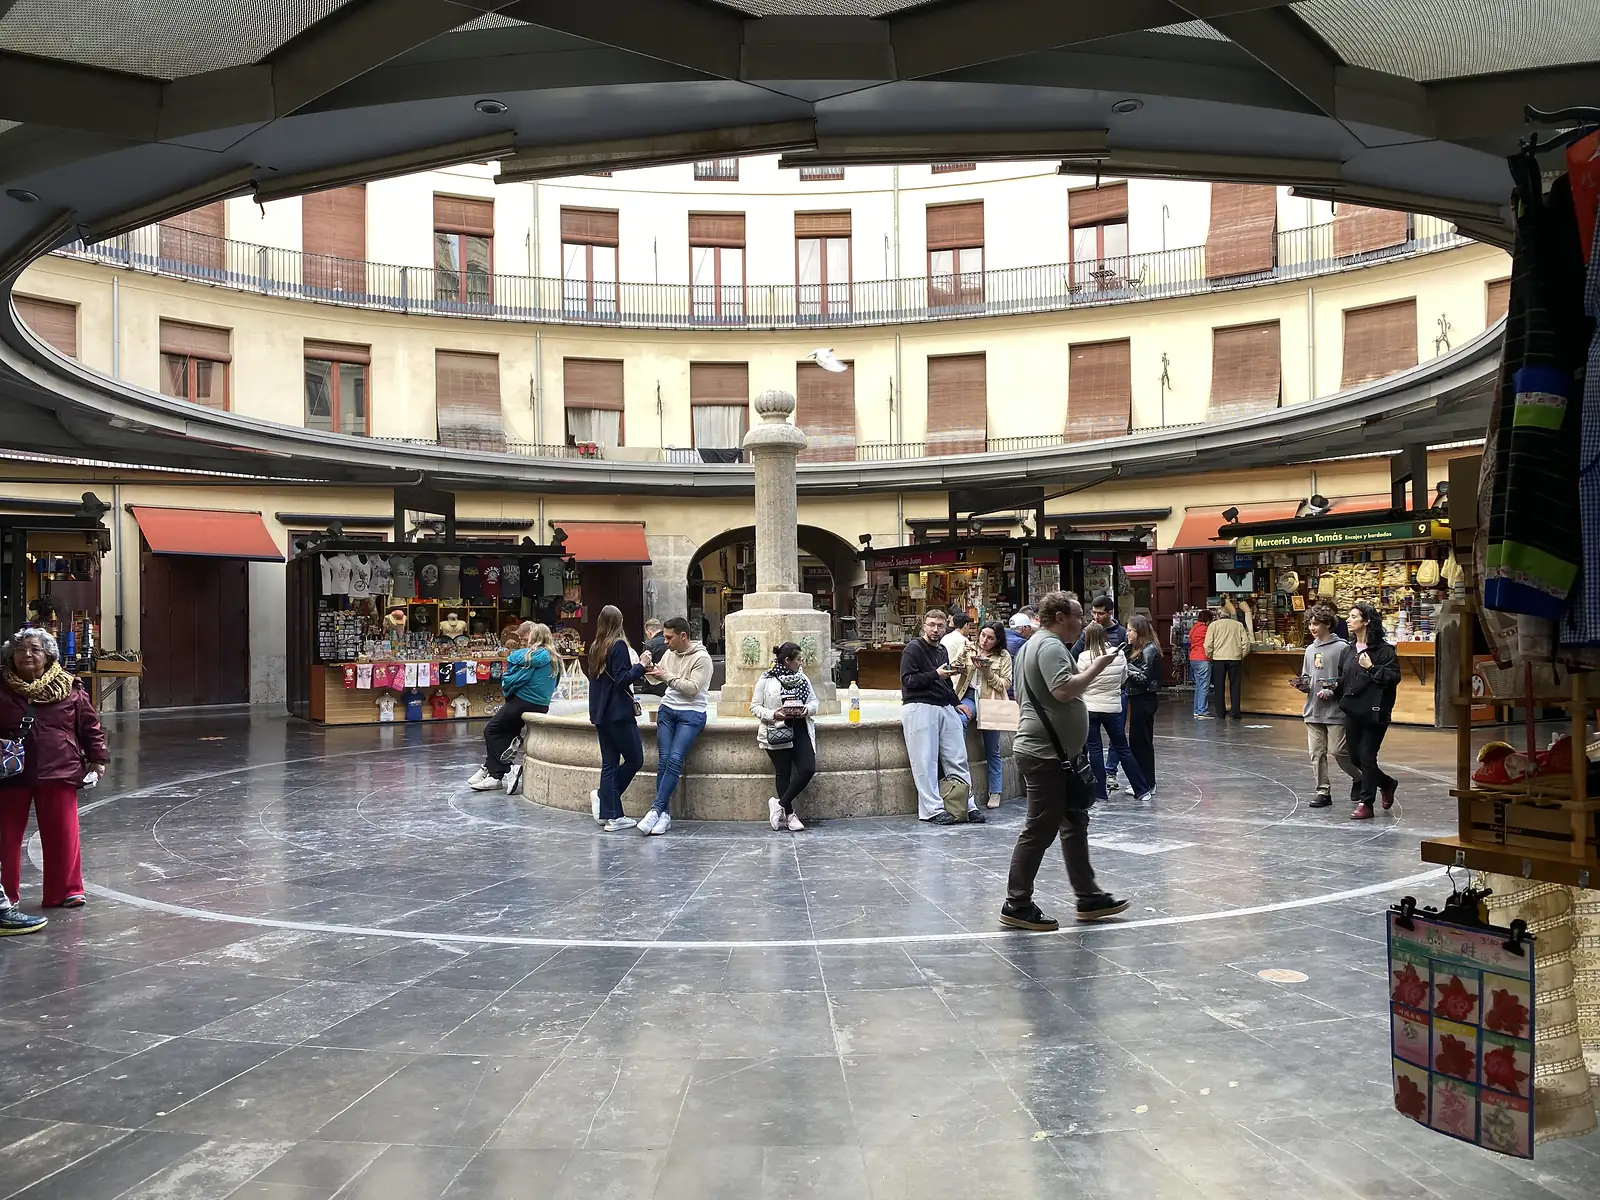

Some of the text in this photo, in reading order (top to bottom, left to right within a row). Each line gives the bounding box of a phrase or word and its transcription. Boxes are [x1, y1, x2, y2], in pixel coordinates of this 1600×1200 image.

[1418, 524, 1427, 534] 9
[1255, 536, 1290, 547] Mercería
[1292, 534, 1313, 544] Rosa
[1314, 532, 1343, 543] Tomás
[959, 552, 964, 560] 7
